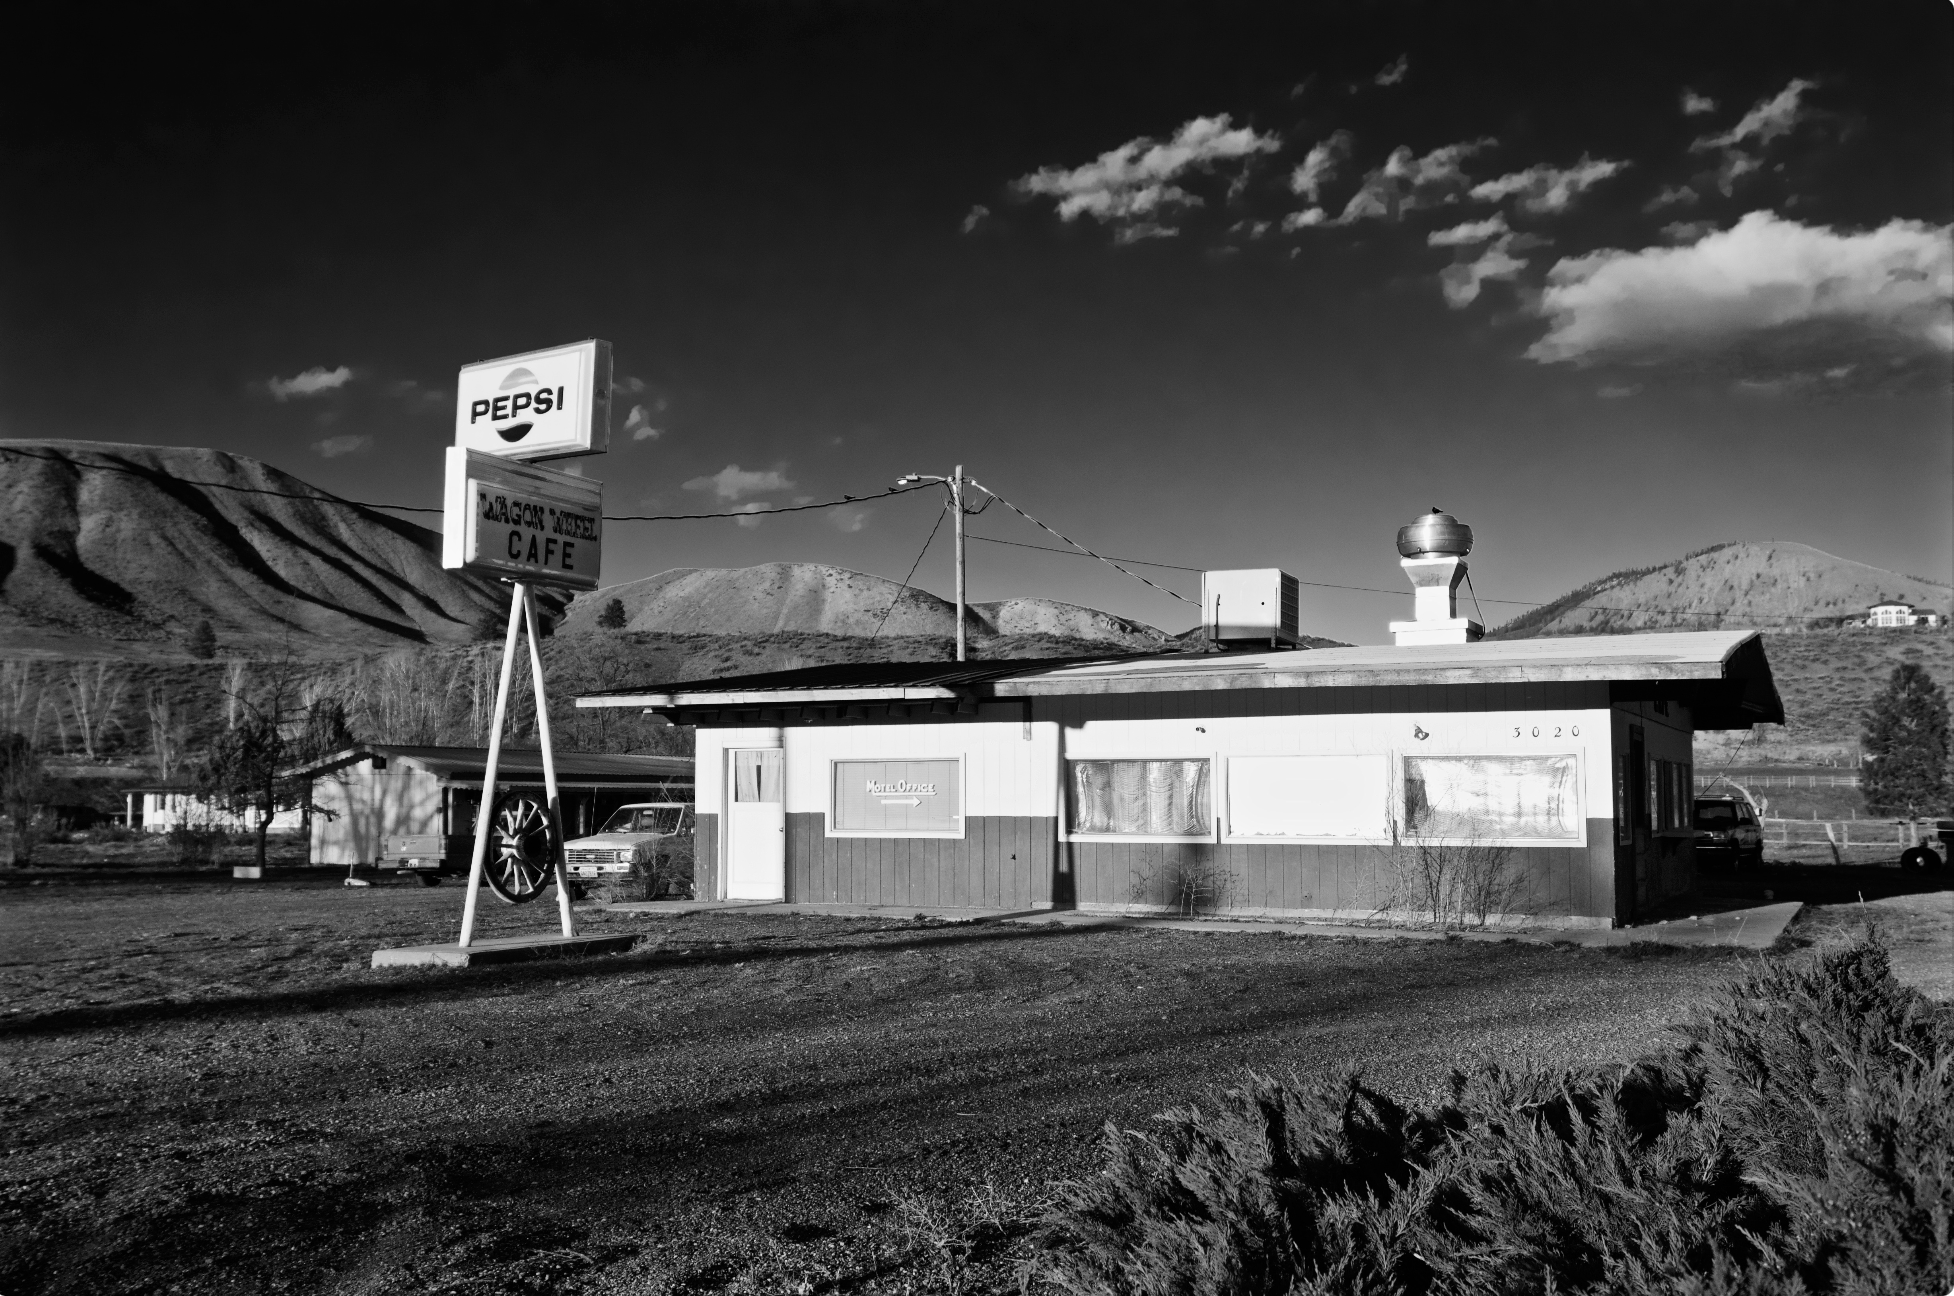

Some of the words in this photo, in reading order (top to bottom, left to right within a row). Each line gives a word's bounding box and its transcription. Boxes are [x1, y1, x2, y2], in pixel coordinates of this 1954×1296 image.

[470, 386, 564, 424] PEPSI
[480, 493, 545, 531] WAGON
[549, 508, 597, 541] WHEEL
[508, 530, 575, 570] CAFE
[1513, 725, 1580, 738] 3020
